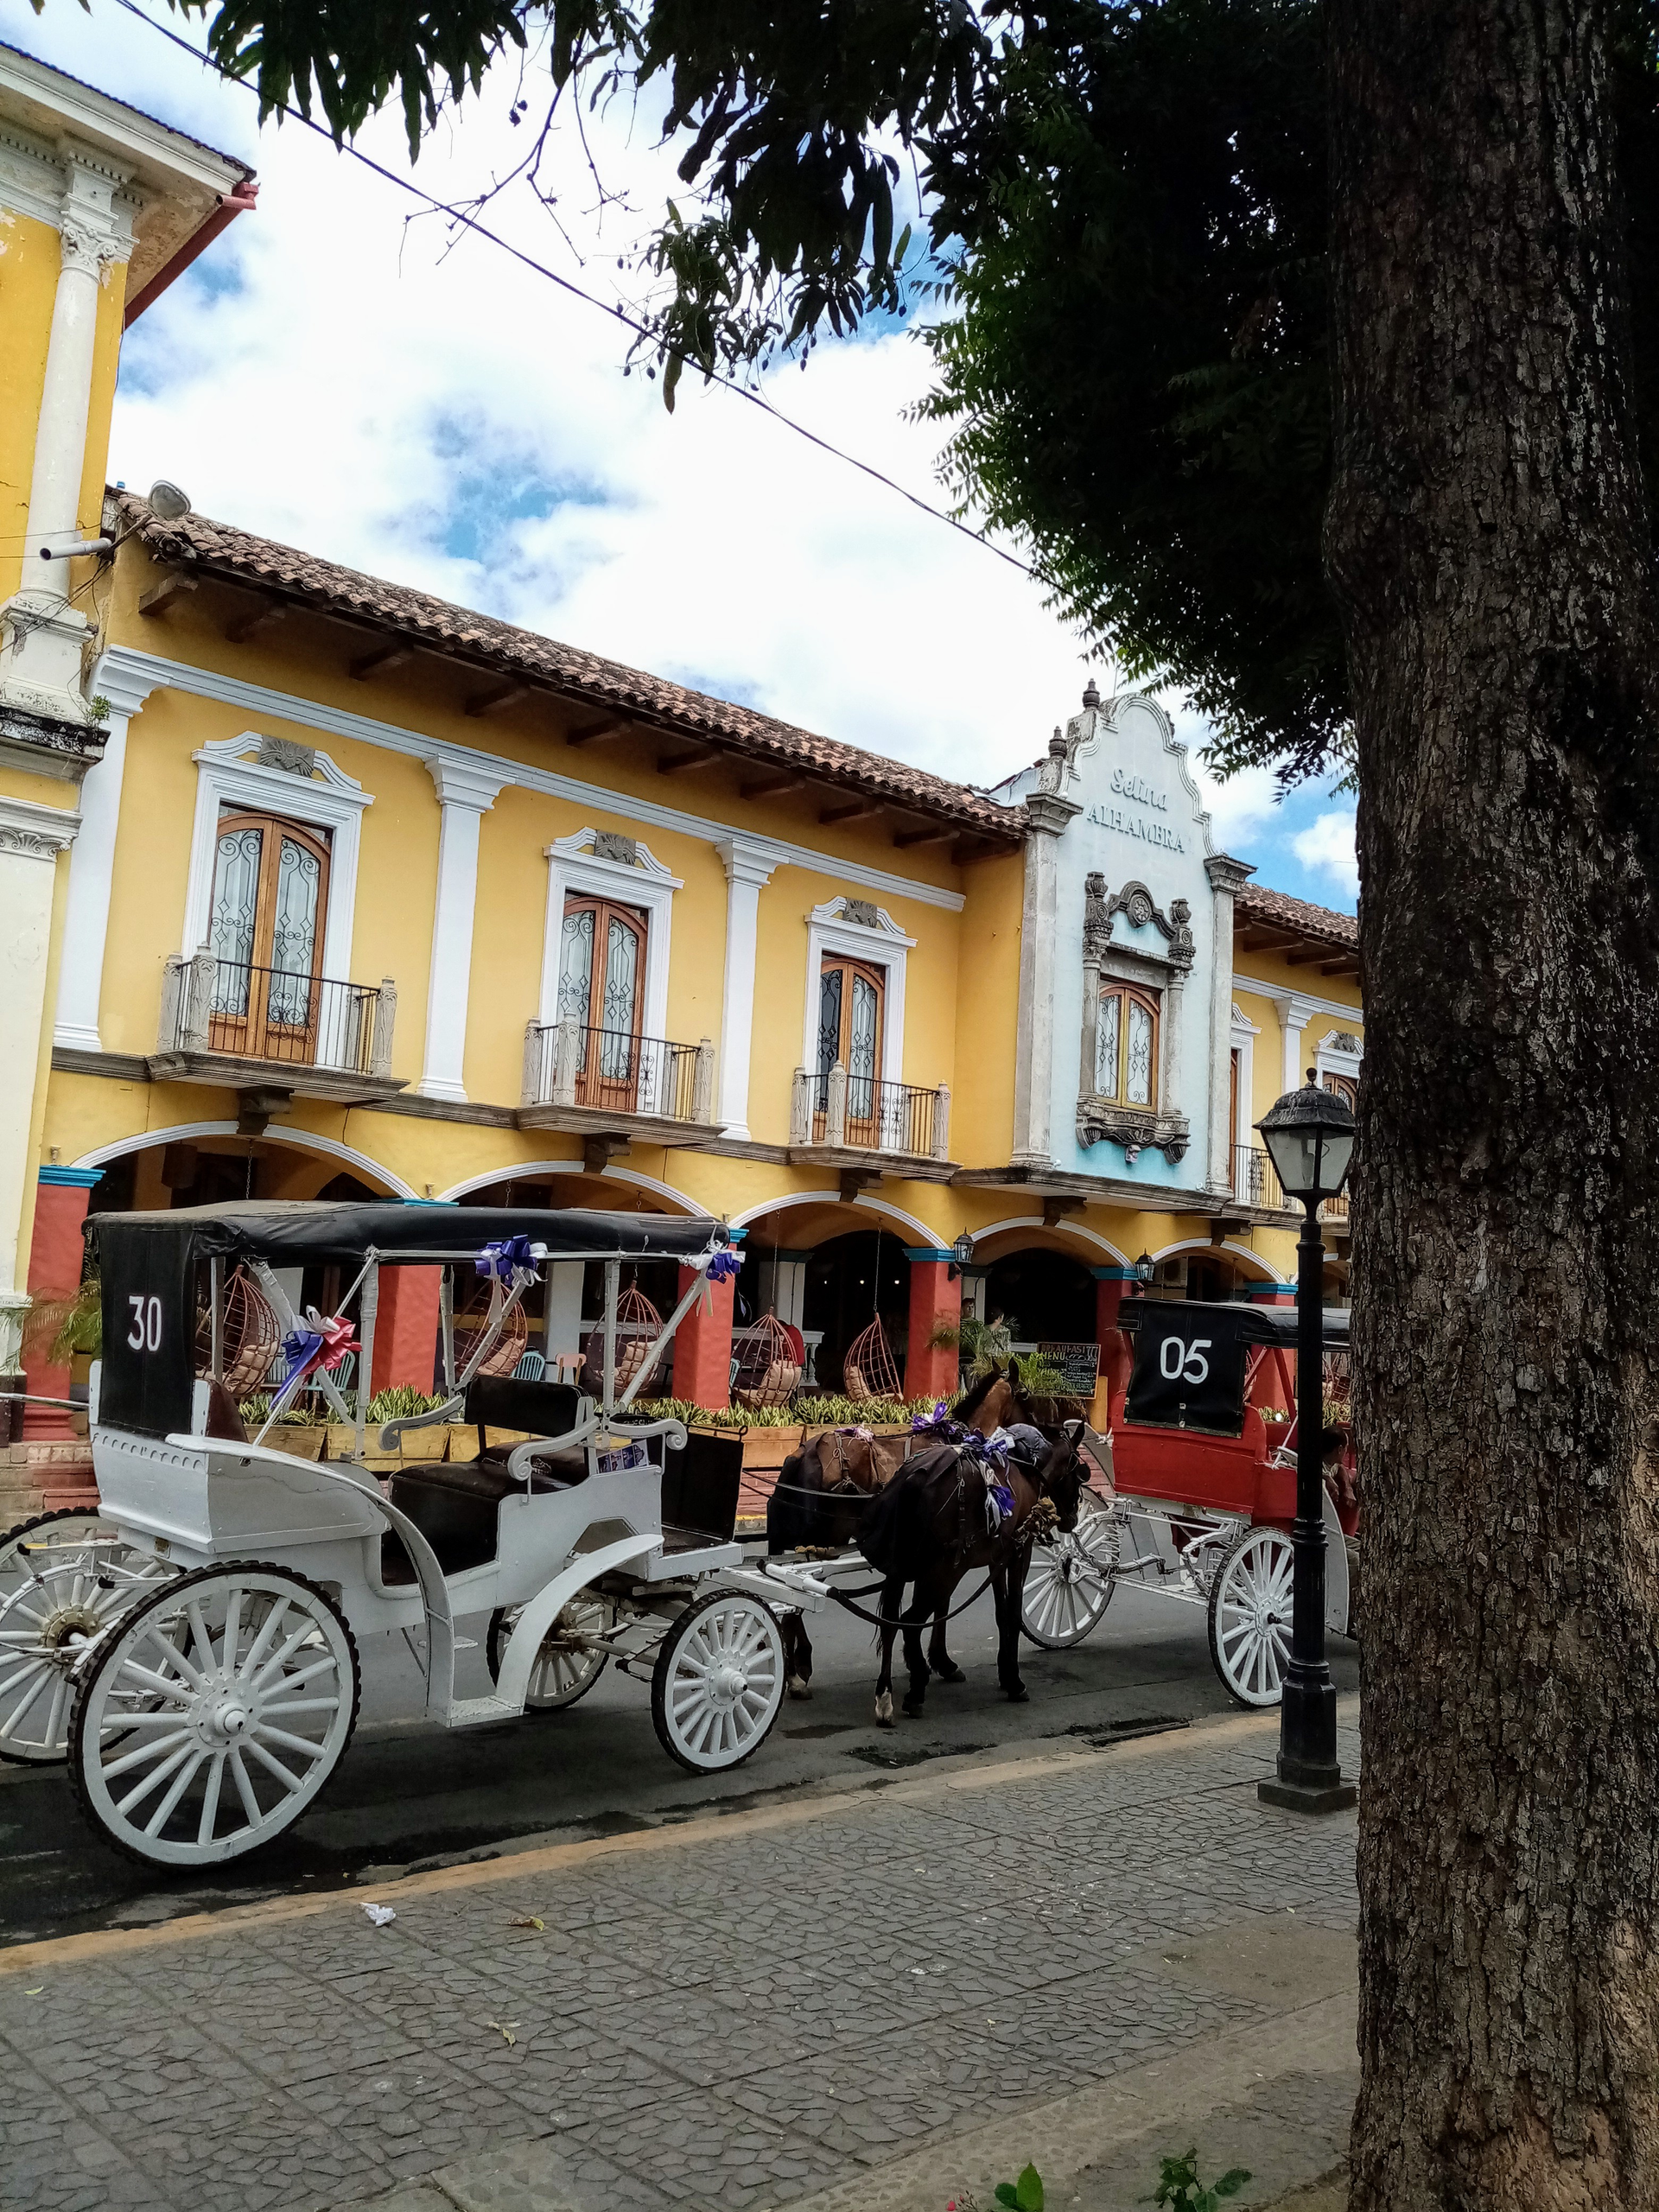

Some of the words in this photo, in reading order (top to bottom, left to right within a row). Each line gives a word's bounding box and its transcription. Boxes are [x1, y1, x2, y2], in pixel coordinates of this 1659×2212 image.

[1111, 767, 1167, 811] Selina
[1087, 803, 1185, 853] ALHAMBRA
[127, 1294, 162, 1352] 30
[1041, 1351, 1065, 1361] MENU
[1160, 1336, 1212, 1384] 05
